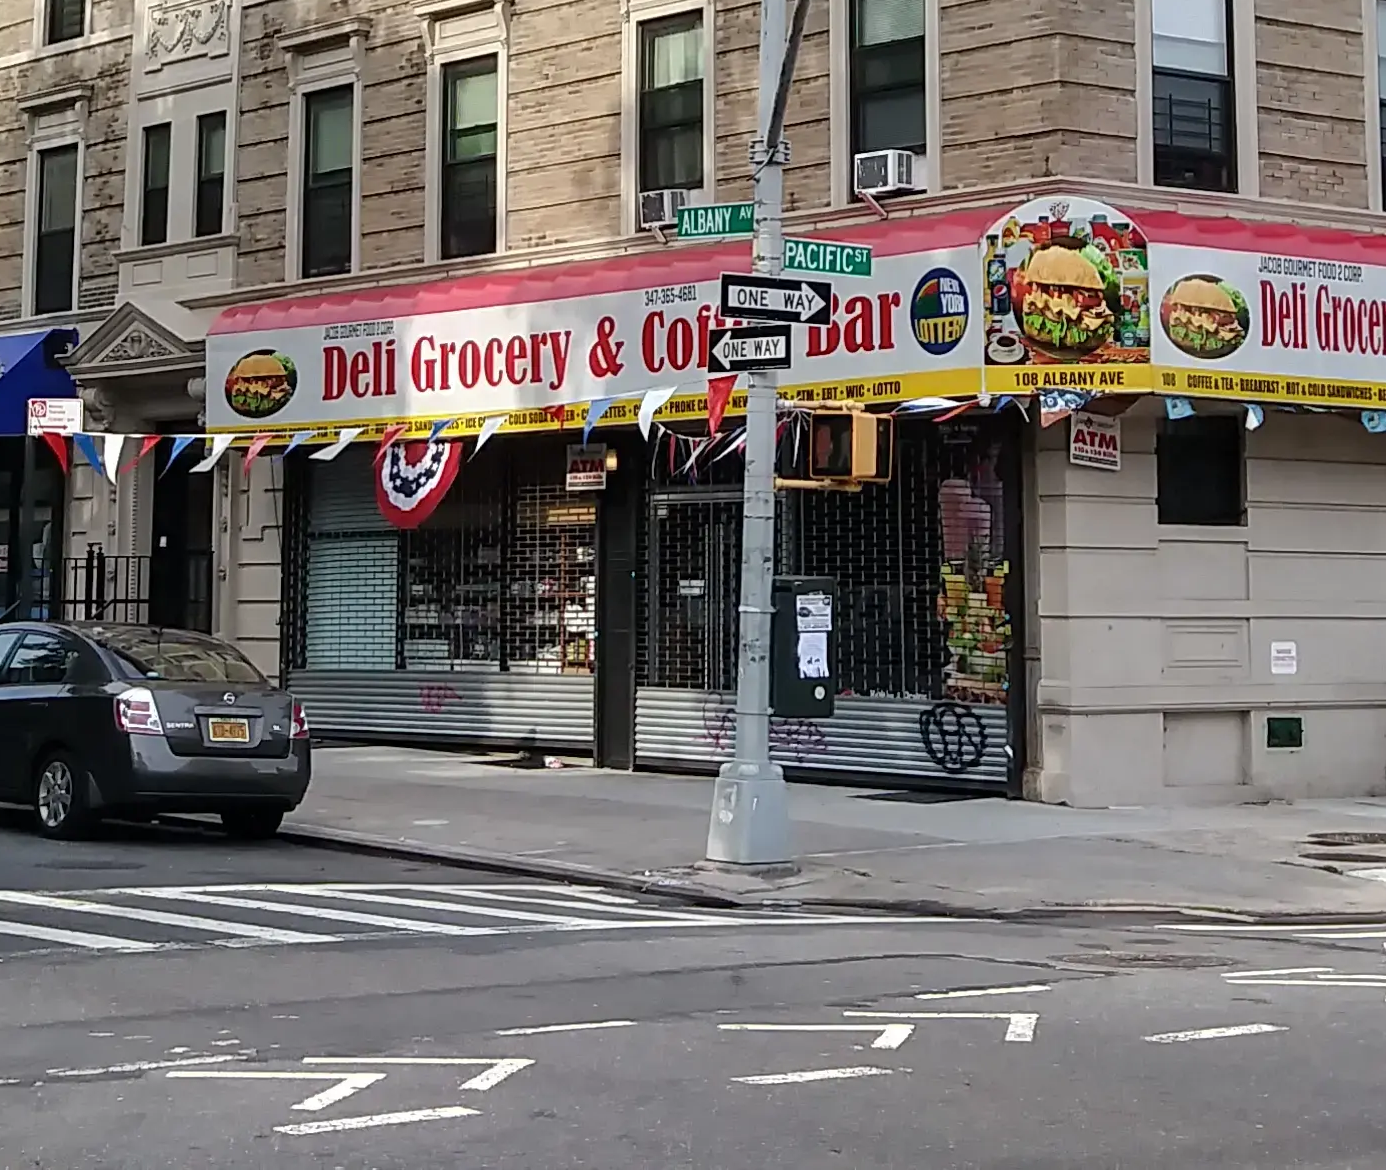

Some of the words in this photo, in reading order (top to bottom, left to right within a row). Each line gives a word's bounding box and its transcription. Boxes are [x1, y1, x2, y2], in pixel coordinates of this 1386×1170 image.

[681, 207, 732, 235] ALBANY
[739, 205, 754, 220] AV
[785, 242, 854, 273] PACIFIC
[855, 249, 869, 263] ST
[1258, 256, 1281, 274] JACOB
[1283, 258, 1316, 278] GOURMET
[1318, 262, 1336, 280] FOOD
[1338, 264, 1343, 281] 2
[644, 285, 696, 307] 347-365-4681
[939, 277, 960, 293] NEW
[737, 288, 769, 308] ONE
[783, 292, 816, 311] WAY
[940, 293, 965, 314] YORK
[1260, 280, 1308, 349] Deli
[914, 314, 967, 344] LOTTERY
[322, 339, 396, 401] Deli
[411, 331, 571, 391] Grocery
[589, 316, 625, 378] &
[723, 340, 747, 359] ONE
[753, 338, 780, 358] WAY
[1014, 372, 1038, 386] 108
[1043, 371, 1095, 386] ALBANY
[1099, 371, 1125, 386] AVE
[1187, 374, 1213, 389] COFFEE
[1221, 377, 1234, 391] TEA
[1240, 378, 1280, 394] BREAKFAST
[1285, 381, 1300, 396] HOT
[1308, 383, 1325, 397] COLD
[1327, 384, 1373, 401] SANDWICHES
[465, 416, 476, 428] ICE
[508, 413, 528, 426] COLD
[669, 399, 696, 414] PHONE
[821, 387, 839, 401] EBT
[846, 384, 865, 399] WIC
[872, 381, 901, 396] LOTTO
[1073, 429, 1117, 450] ATM
[569, 459, 605, 473] ATM
